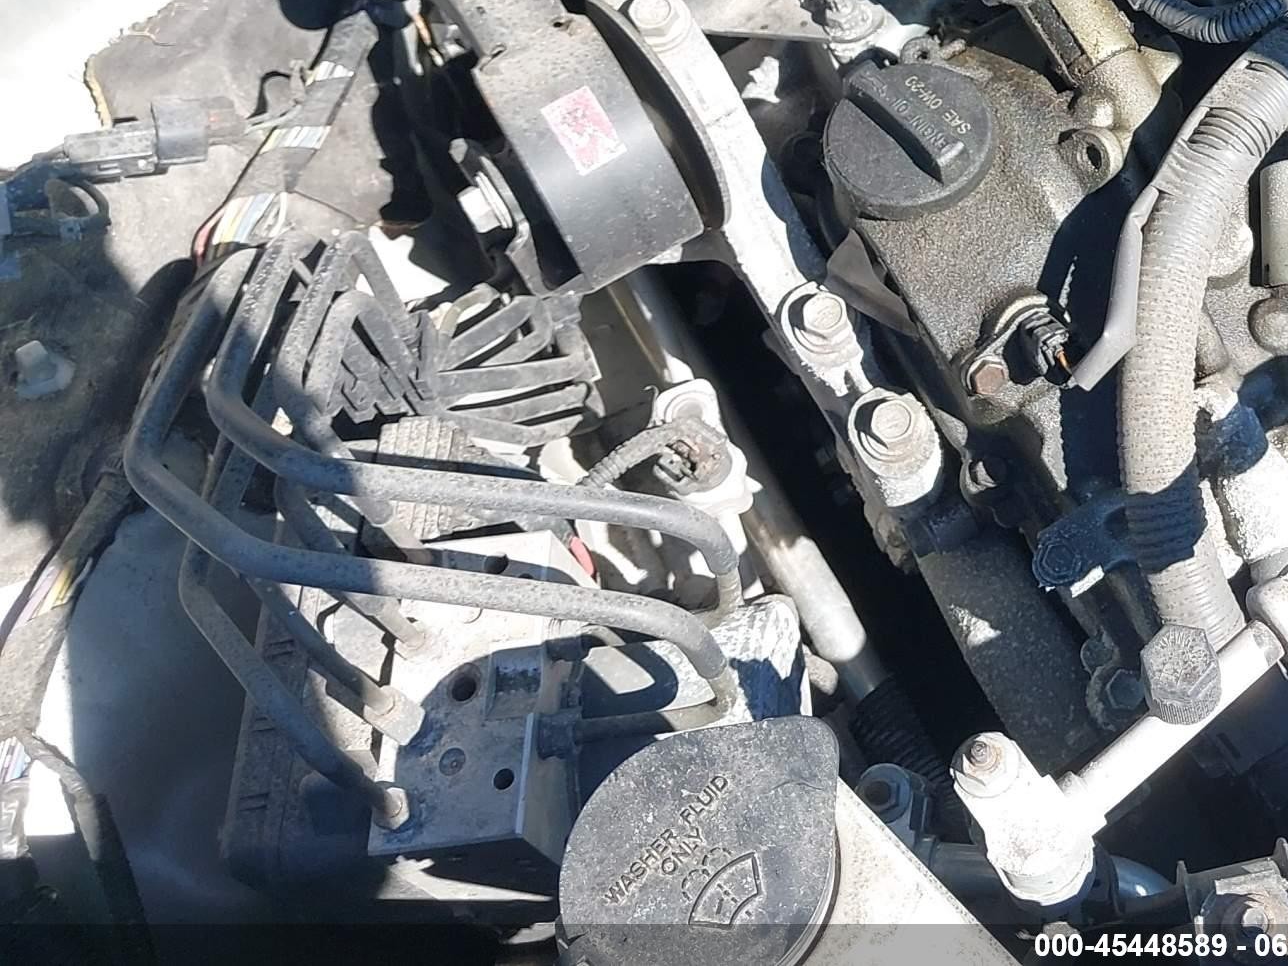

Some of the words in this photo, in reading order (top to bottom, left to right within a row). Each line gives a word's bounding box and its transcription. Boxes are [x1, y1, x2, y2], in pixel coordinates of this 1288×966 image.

[904, 75, 943, 111] 0W-20
[943, 109, 972, 135] SAE
[603, 827, 679, 906] WASHER
[680, 774, 730, 826] FLUID
[660, 827, 706, 876] ONLY
